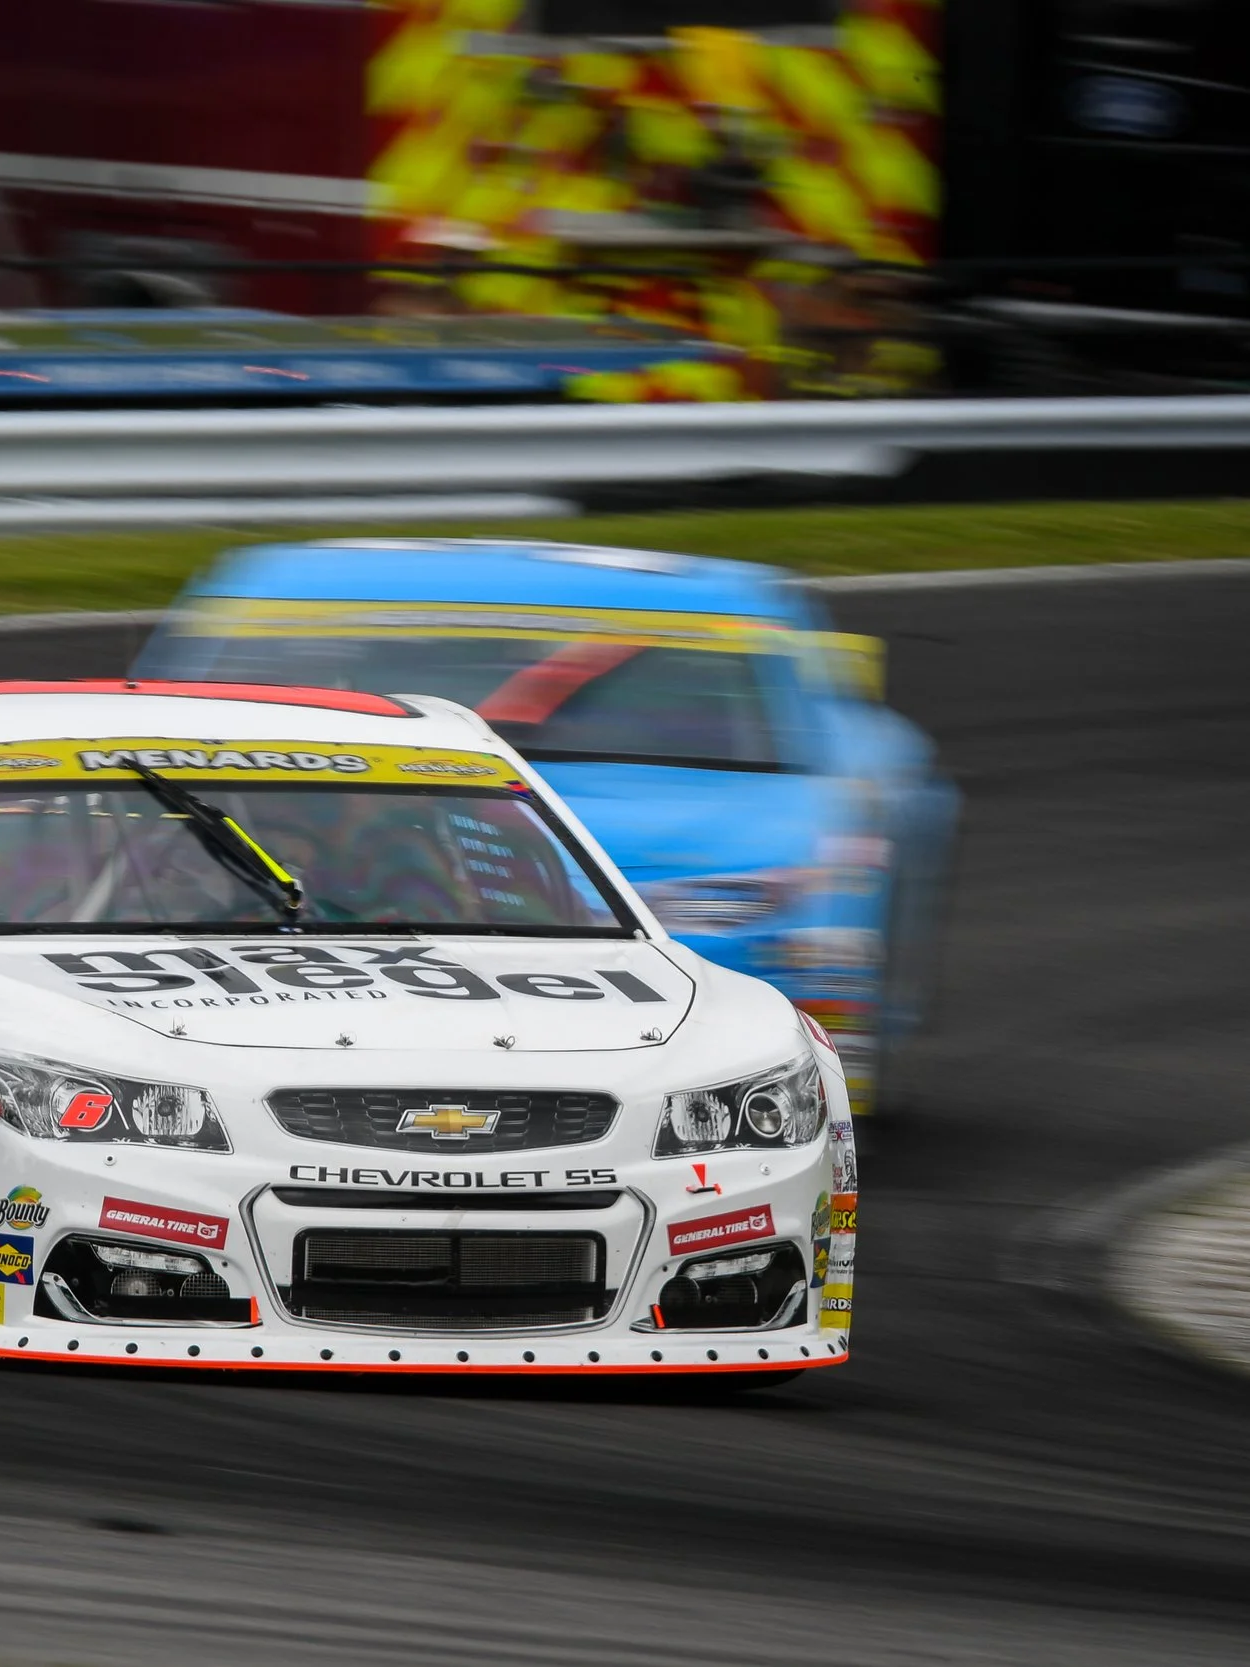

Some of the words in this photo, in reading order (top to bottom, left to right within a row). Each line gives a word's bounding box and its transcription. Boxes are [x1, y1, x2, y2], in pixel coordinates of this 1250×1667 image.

[78, 749, 370, 773] MENARDS
[41, 946, 460, 973] max
[107, 989, 388, 1009] INCORPORATED
[59, 1093, 114, 1129] 6
[289, 1165, 550, 1188] CHEVROLET
[565, 1169, 618, 1186] SS
[106, 1209, 165, 1229] GENERAL
[165, 1220, 197, 1234] TIRE
[673, 1226, 725, 1244] GENERAL
[725, 1220, 750, 1235] TIRE
